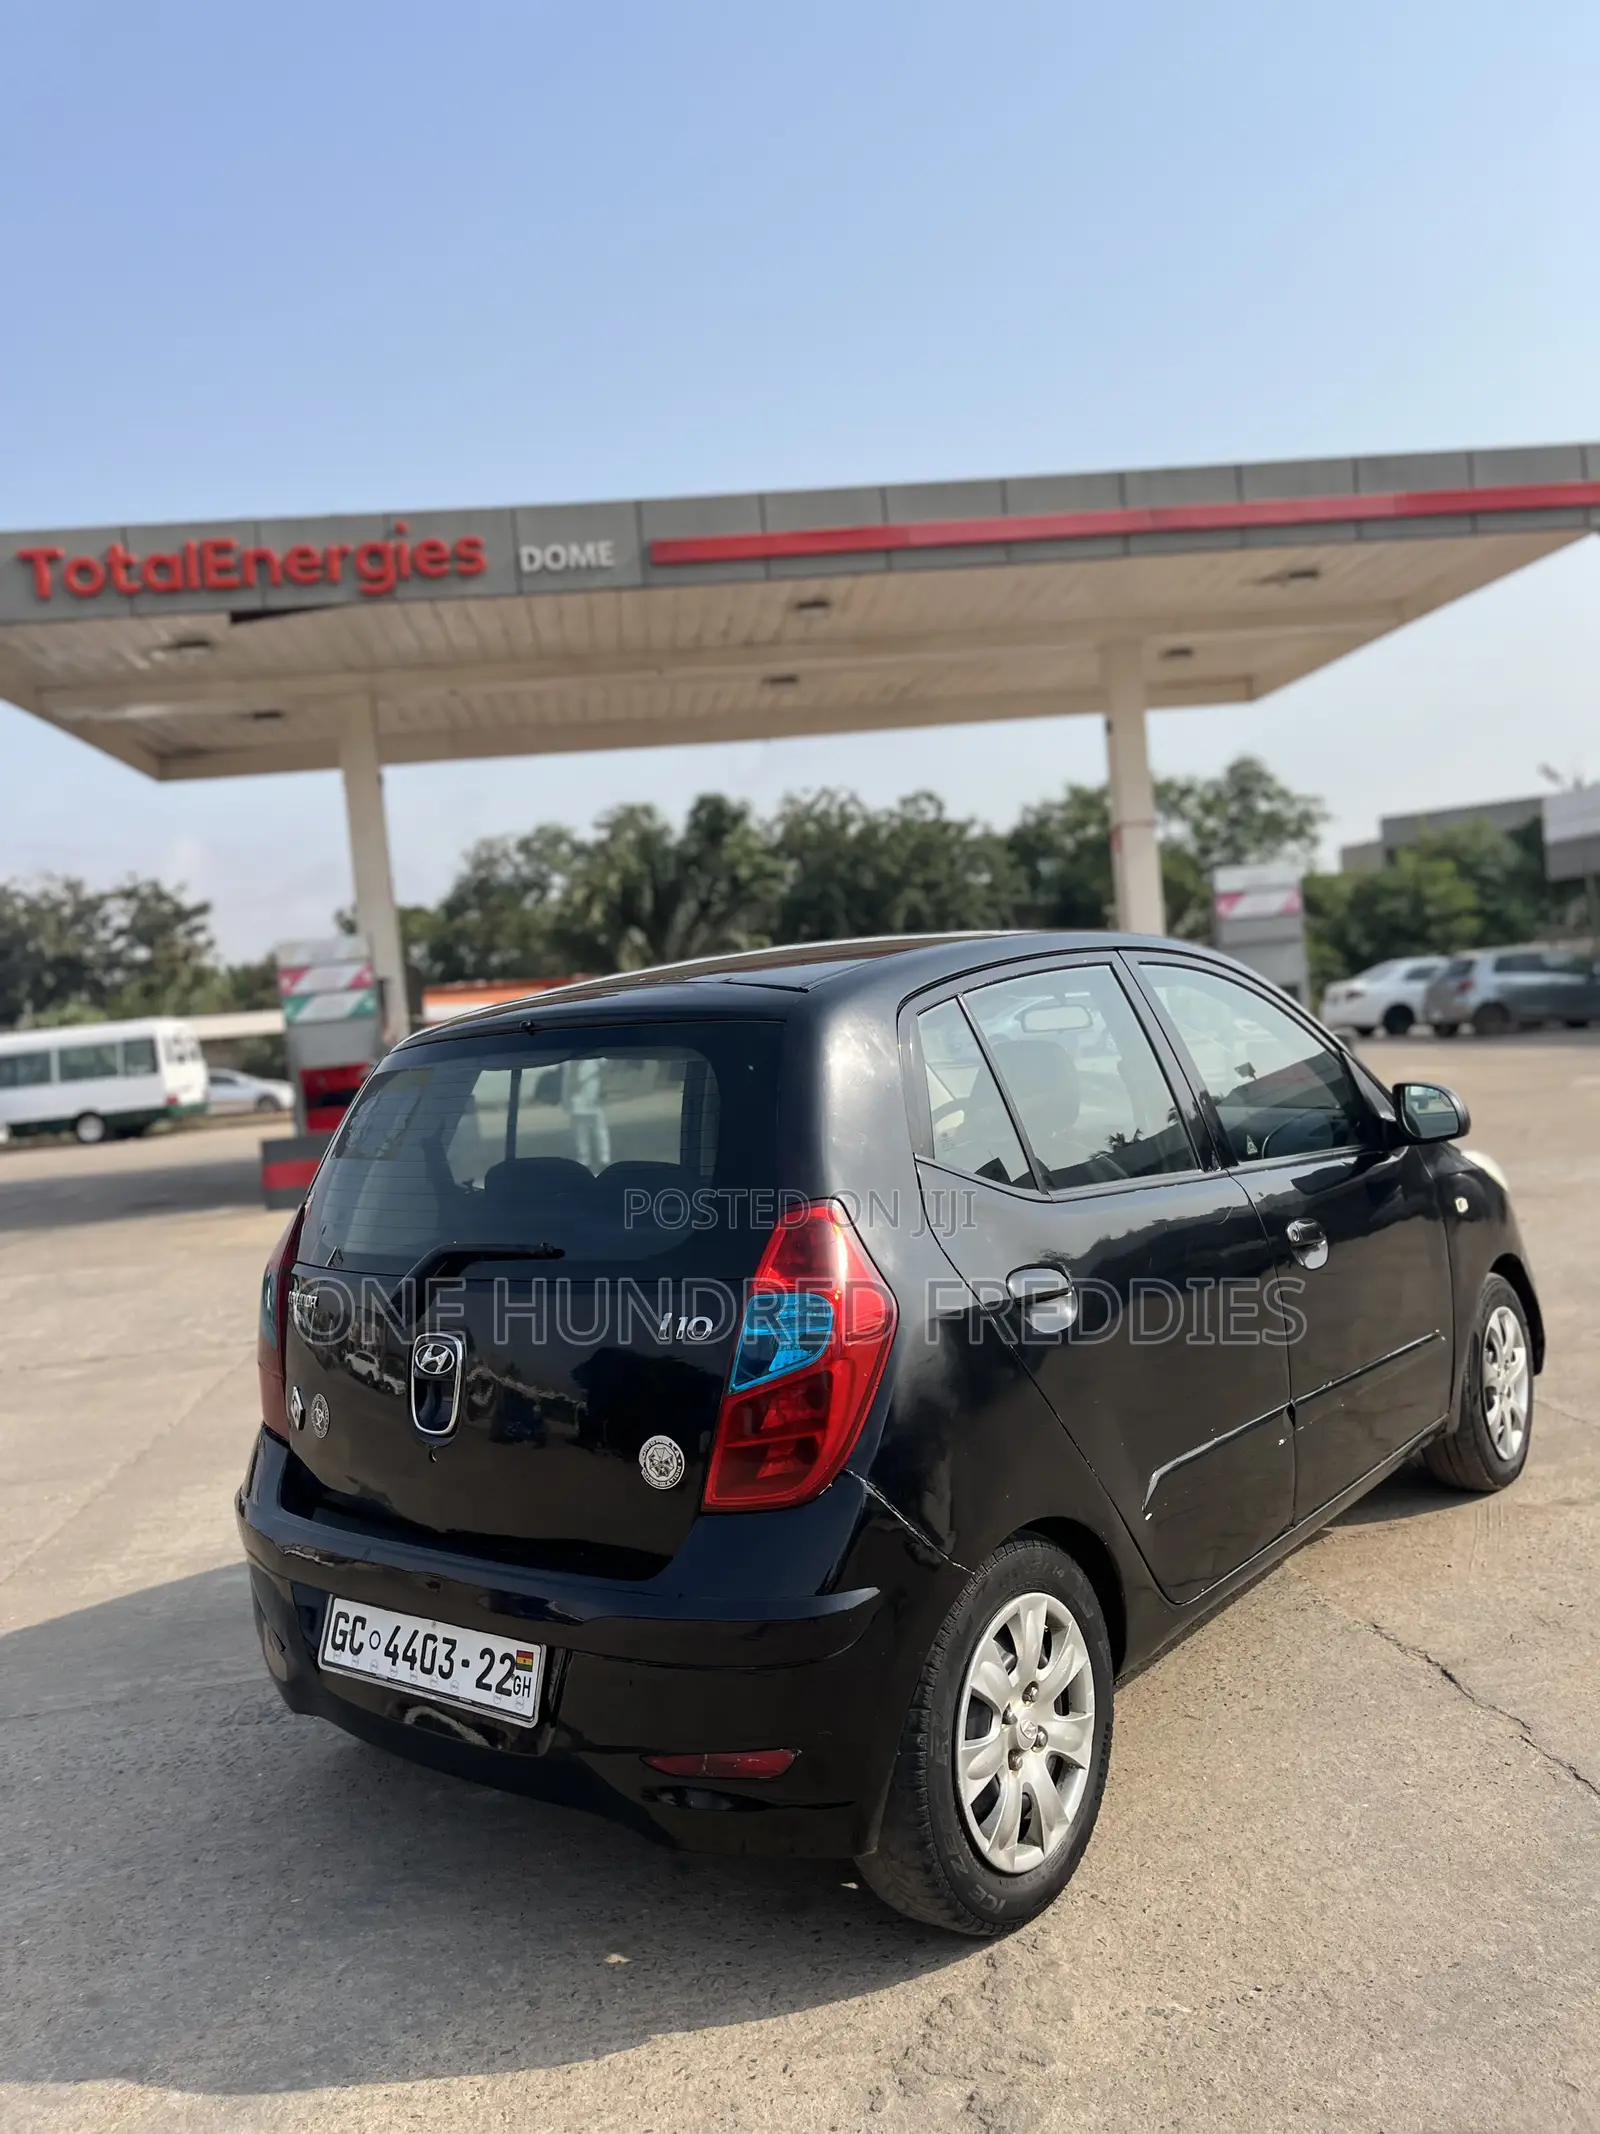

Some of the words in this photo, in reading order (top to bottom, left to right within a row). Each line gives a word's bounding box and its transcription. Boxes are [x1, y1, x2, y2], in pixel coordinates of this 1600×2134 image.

[16, 520, 487, 597] TotalEnergies
[518, 541, 616, 573] DOME
[331, 1611, 367, 1655] GC
[513, 1675, 532, 1698] GH
